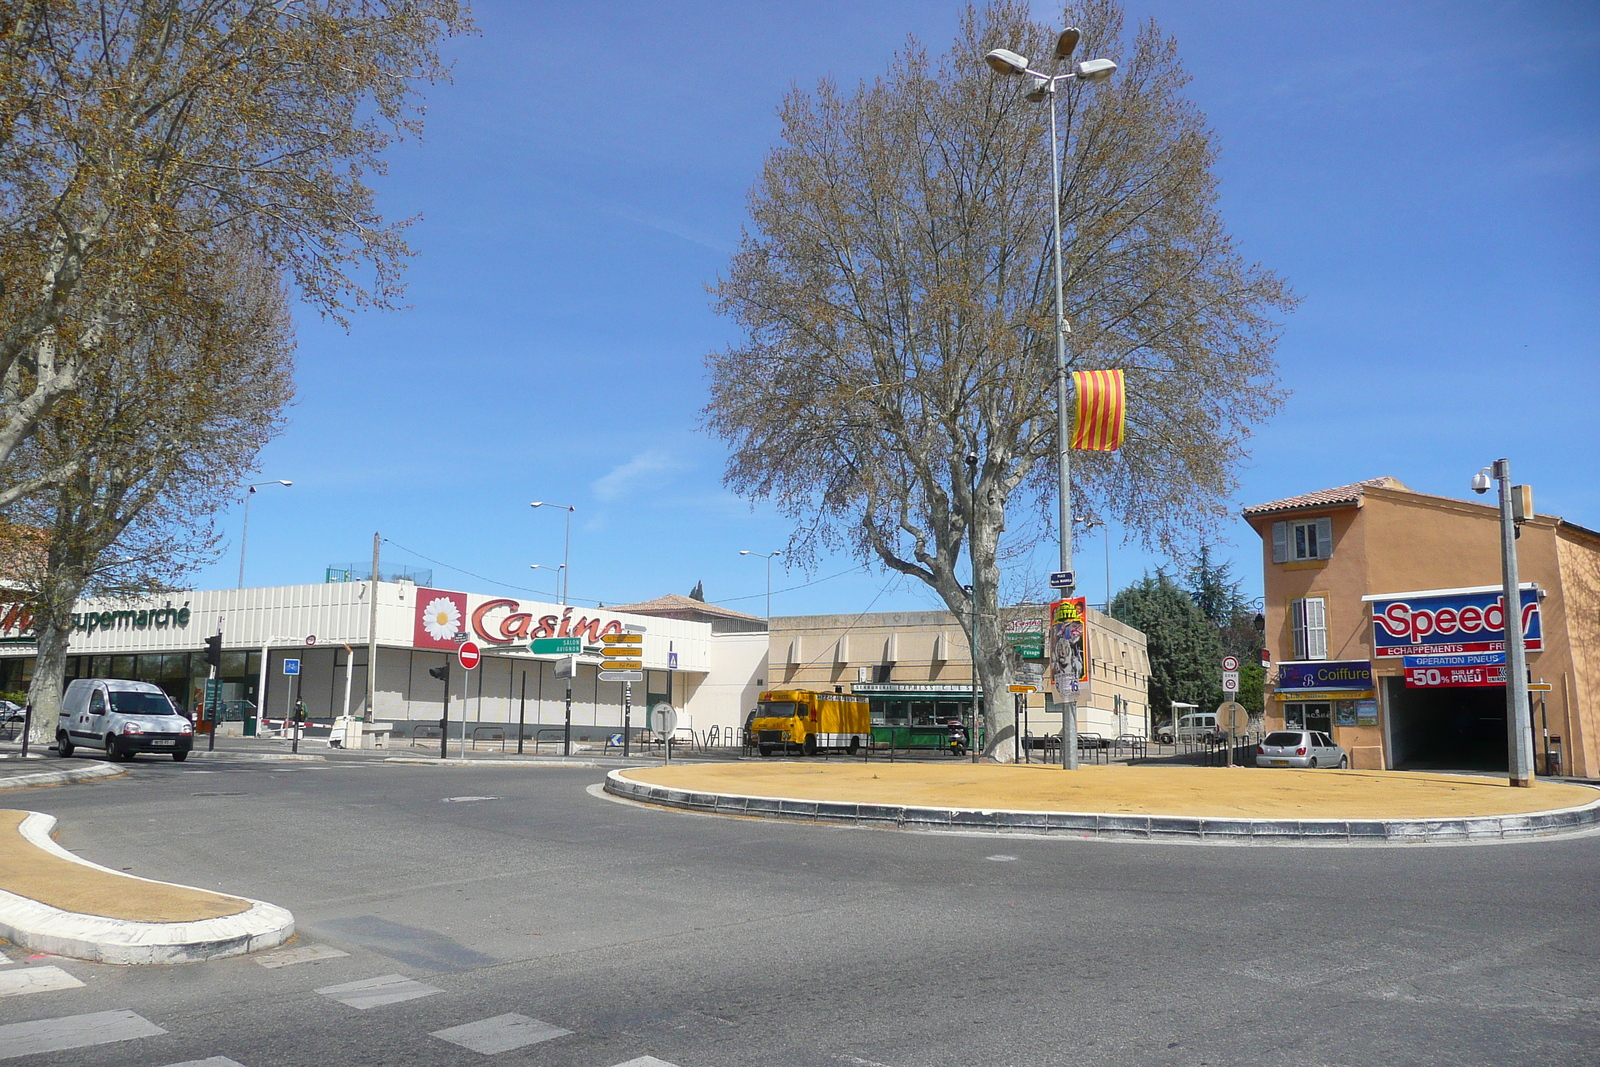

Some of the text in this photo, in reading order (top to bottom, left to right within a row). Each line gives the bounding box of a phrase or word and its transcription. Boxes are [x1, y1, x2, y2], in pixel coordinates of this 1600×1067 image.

[471, 598, 623, 643] Casino
[1387, 644, 1463, 655] ECHAPPEMENTS
[1416, 654, 1499, 665] OPERATION PNEUS
[1317, 667, 1370, 681] Coiffure
[1451, 674, 1482, 683] PNEU
